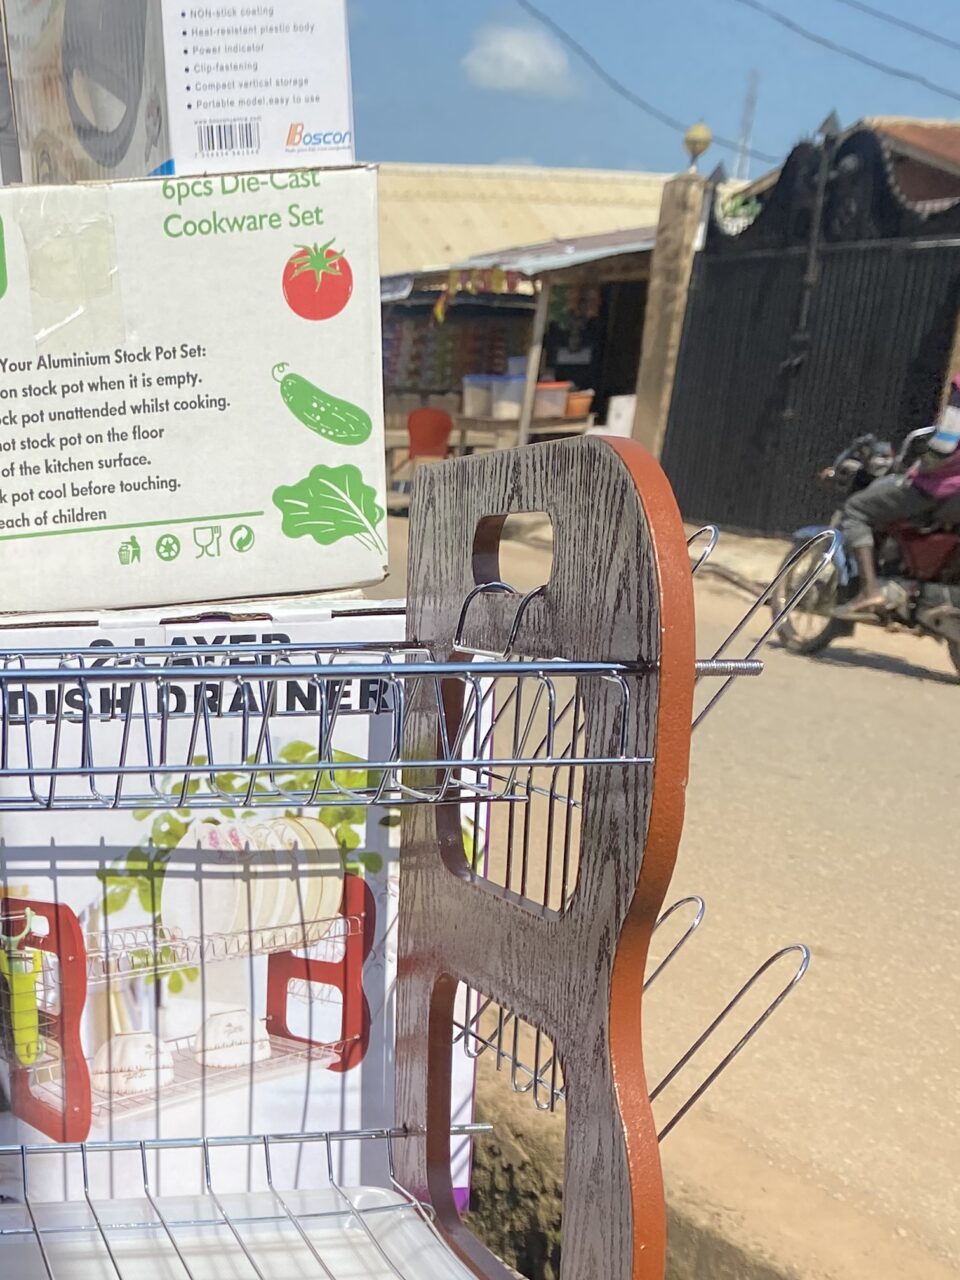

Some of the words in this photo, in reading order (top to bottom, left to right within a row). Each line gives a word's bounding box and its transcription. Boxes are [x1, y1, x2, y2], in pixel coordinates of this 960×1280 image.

[190, 8, 237, 19] NON-stick
[240, 6, 274, 17] coating
[191, 25, 257, 38] Heat-resistant
[260, 23, 290, 35] plastic
[293, 22, 315, 34] body
[192, 45, 221, 56] Power
[194, 62, 258, 75] Clip-fastening
[195, 80, 235, 92] Compact
[239, 77, 272, 89] vertical
[275, 77, 309, 88] storage
[196, 97, 235, 110] Portable
[292, 95, 301, 104] to
[304, 95, 320, 104] use
[286, 122, 352, 146] Boscon
[162, 177, 213, 206] 6pcs
[221, 171, 320, 195] Die-Cast
[163, 211, 282, 238] Cookware
[288, 203, 324, 228] Set
[36, 352, 110, 371] Aluminium
[114, 346, 152, 364] Stock
[155, 345, 176, 361] Pot
[180, 344, 206, 359] Set:
[0, 387, 18, 400] on
[22, 380, 57, 397] stock
[61, 380, 84, 398] pot
[87, 375, 125, 392] when
[129, 373, 138, 389] it
[141, 373, 152, 387] is
[156, 371, 203, 389] empty.
[21, 409, 44, 428] pot
[48, 400, 127, 422] unattended
[130, 397, 170, 415] whilst
[173, 393, 231, 412] cooking.
[20, 432, 55, 450] stock
[59, 433, 82, 451] pot
[85, 432, 103, 444] on
[107, 427, 128, 442] the
[132, 425, 165, 440] floor
[1, 462, 16, 478] of
[19, 460, 41, 476] the
[44, 456, 94, 474] kitchen
[97, 452, 152, 470] surface.
[12, 488, 34, 507] pot
[38, 483, 66, 501] cool
[71, 481, 116, 498] before
[120, 475, 181, 492] touching.
[34, 510, 49, 526] of
[52, 507, 107, 525] children
[8, 686, 131, 725] DISH
